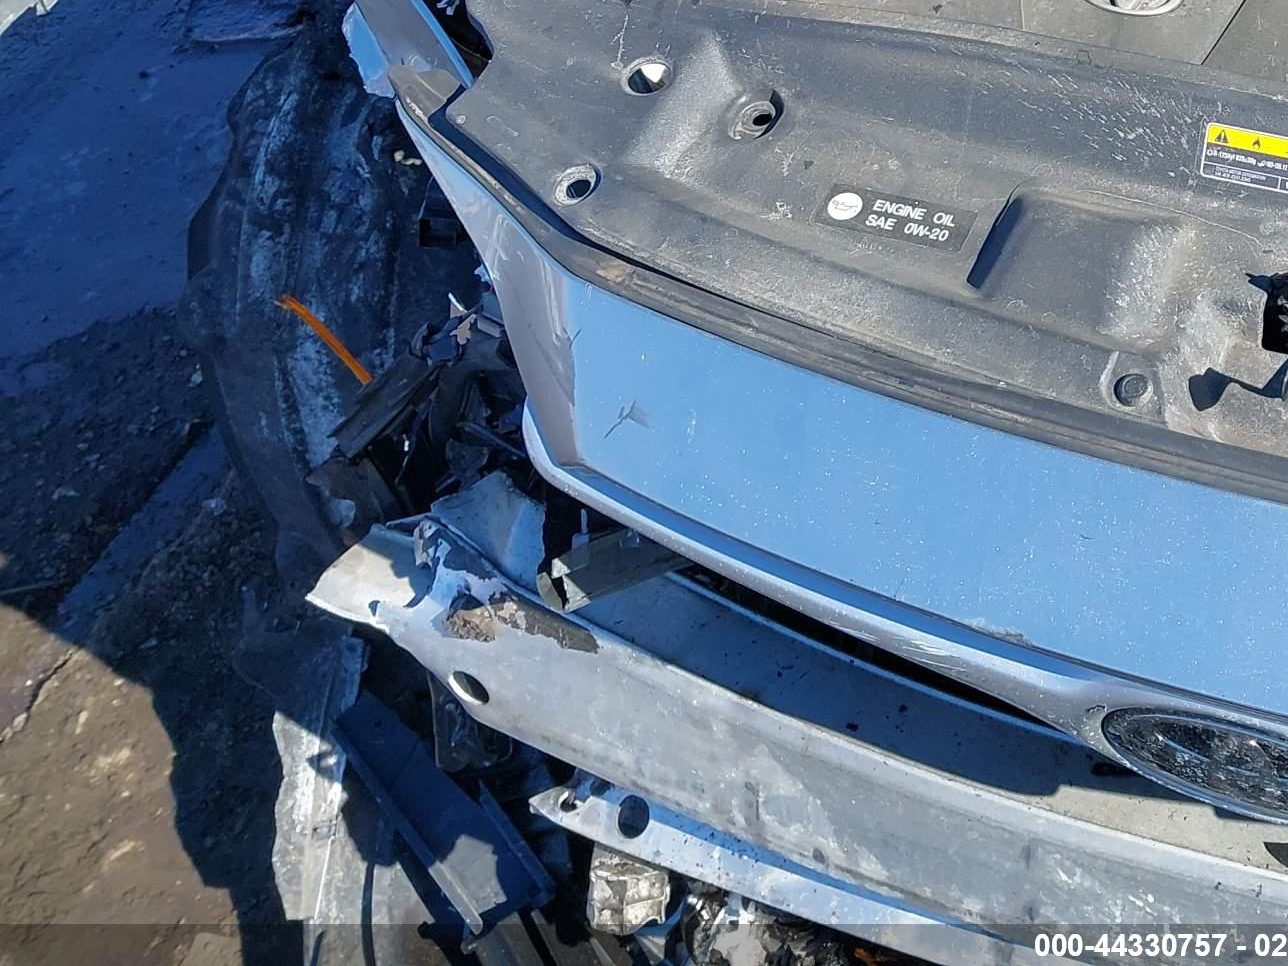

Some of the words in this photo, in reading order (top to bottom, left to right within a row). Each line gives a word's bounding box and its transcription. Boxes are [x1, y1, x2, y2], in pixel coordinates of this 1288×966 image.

[873, 199, 927, 221] ENGINE
[932, 212, 955, 227] OIL
[865, 214, 897, 230] SAE
[903, 222, 950, 241] 0W-20
